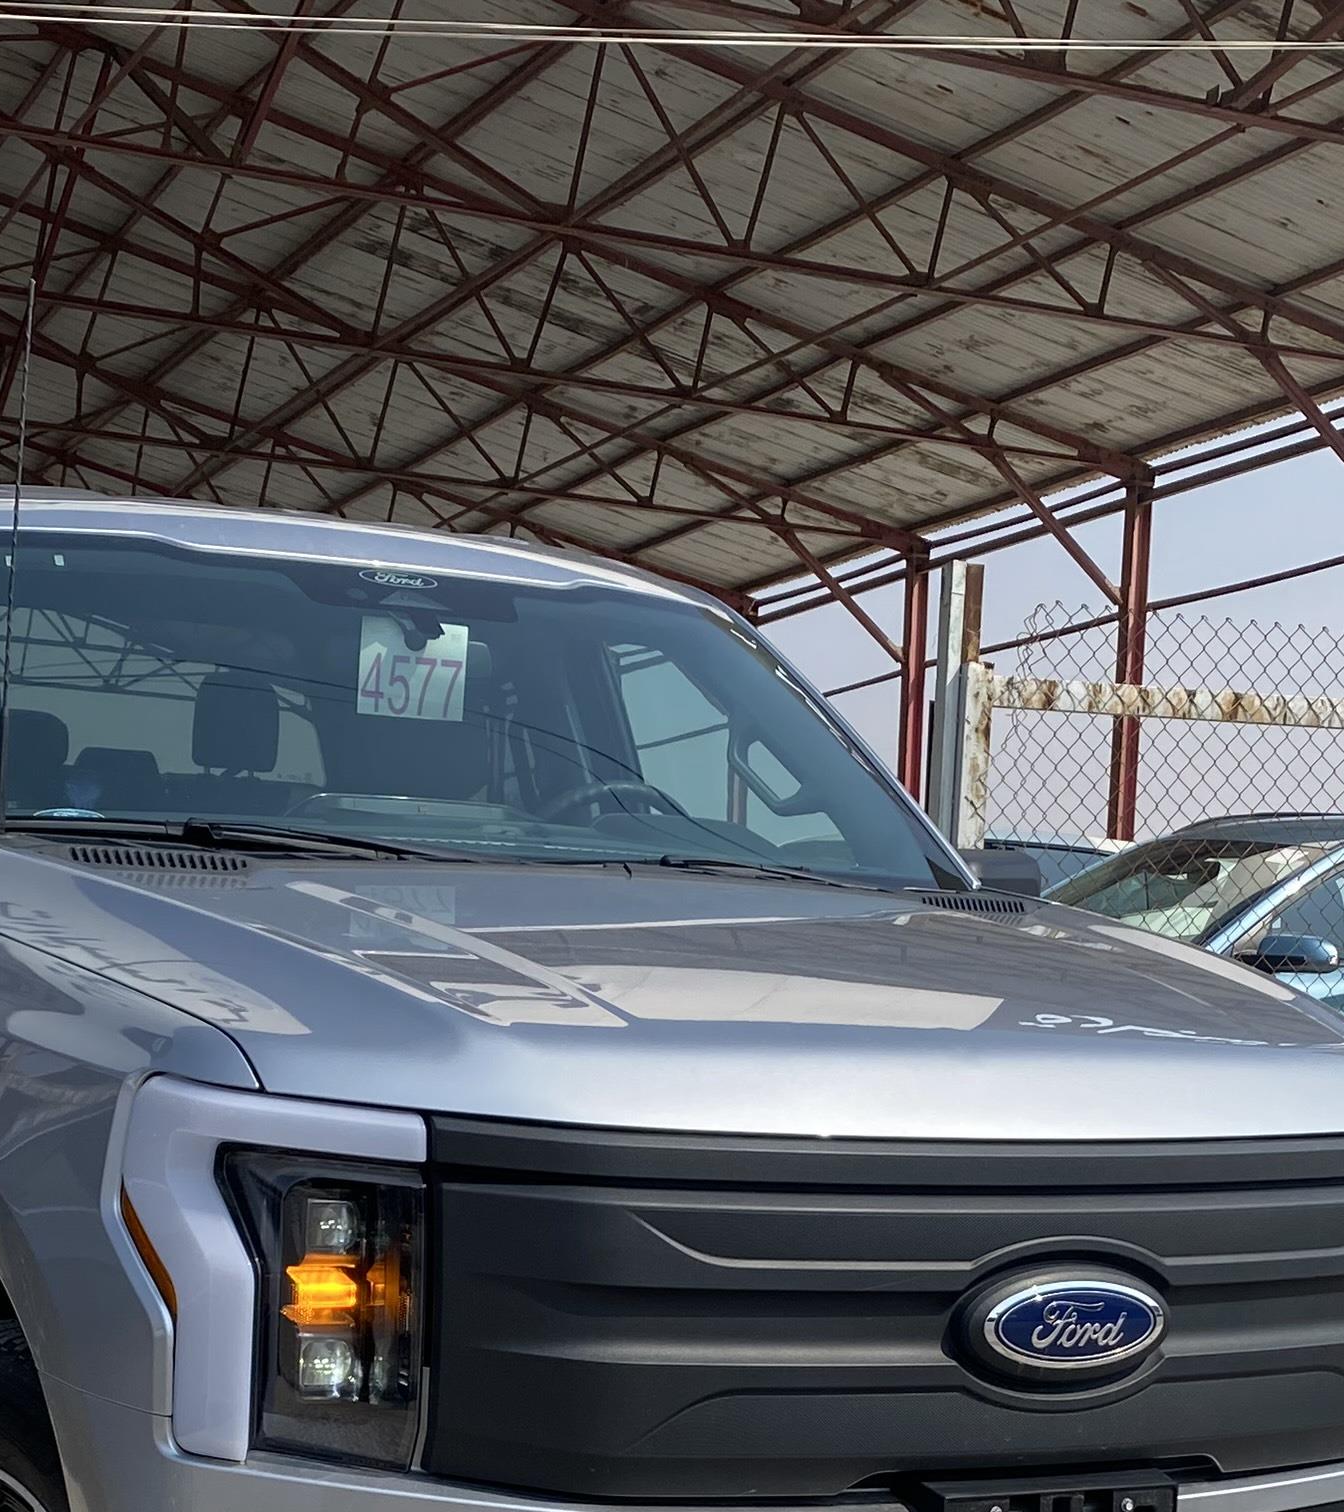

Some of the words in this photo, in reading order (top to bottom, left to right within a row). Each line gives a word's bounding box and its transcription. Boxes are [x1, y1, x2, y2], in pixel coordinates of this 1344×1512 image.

[374, 571, 424, 587] Ford
[360, 652, 463, 718] 4577
[1031, 1300, 1127, 1348] Ford
